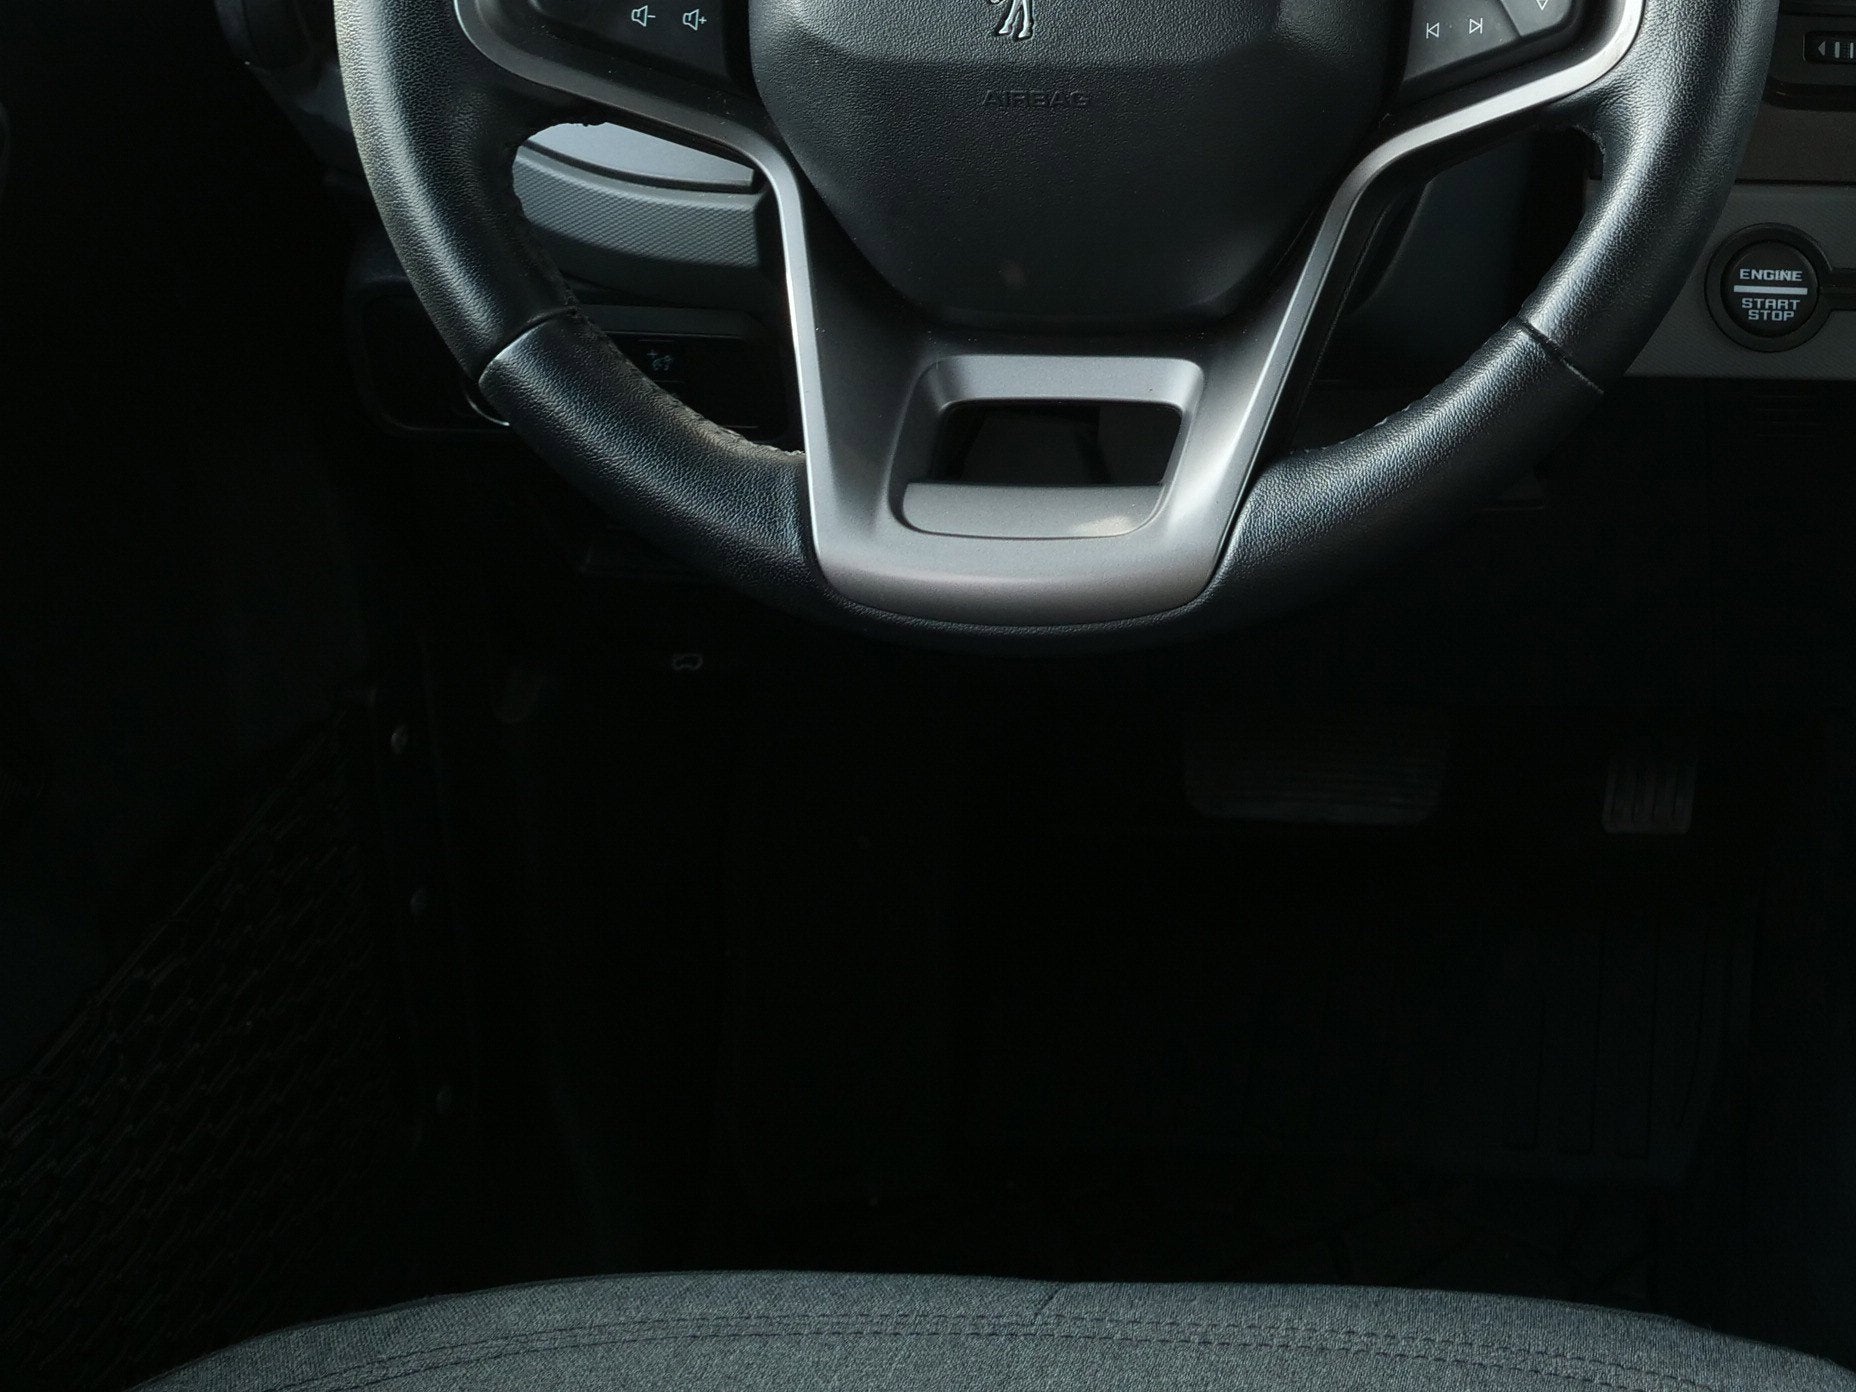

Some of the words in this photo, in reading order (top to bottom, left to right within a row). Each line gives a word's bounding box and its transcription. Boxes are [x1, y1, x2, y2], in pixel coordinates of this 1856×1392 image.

[982, 89, 1090, 107] AIRBAG
[1739, 268, 1803, 282] ENGINE
[1741, 297, 1801, 311] START
[1748, 310, 1795, 322] STOP
